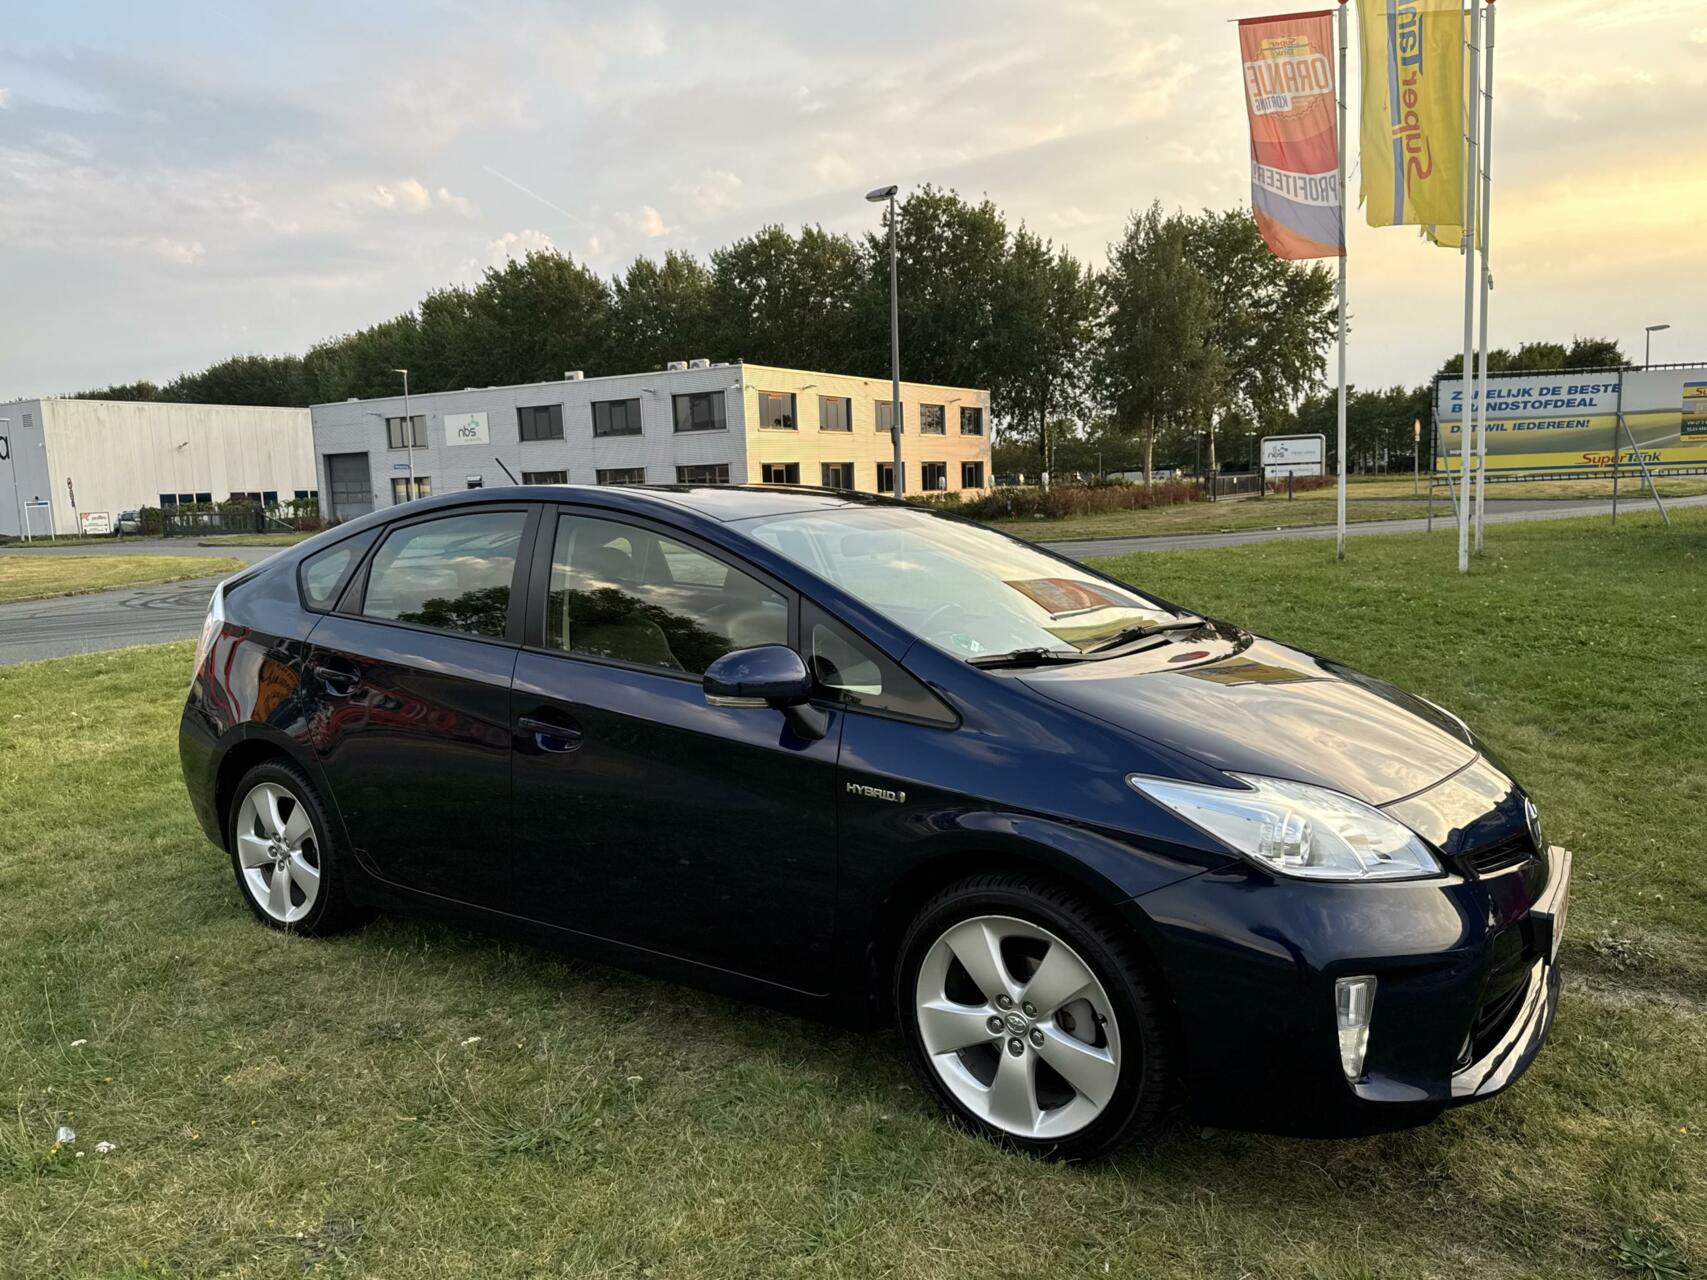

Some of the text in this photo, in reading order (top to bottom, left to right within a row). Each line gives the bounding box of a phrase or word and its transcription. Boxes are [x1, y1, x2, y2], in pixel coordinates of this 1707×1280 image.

[1451, 383, 1622, 400] ZELIJK DE BESTE
[458, 424, 476, 437] nbs
[1450, 424, 1478, 433] DT
[1512, 419, 1590, 431] IEDEREEN!
[846, 782, 898, 802] HYBRID
